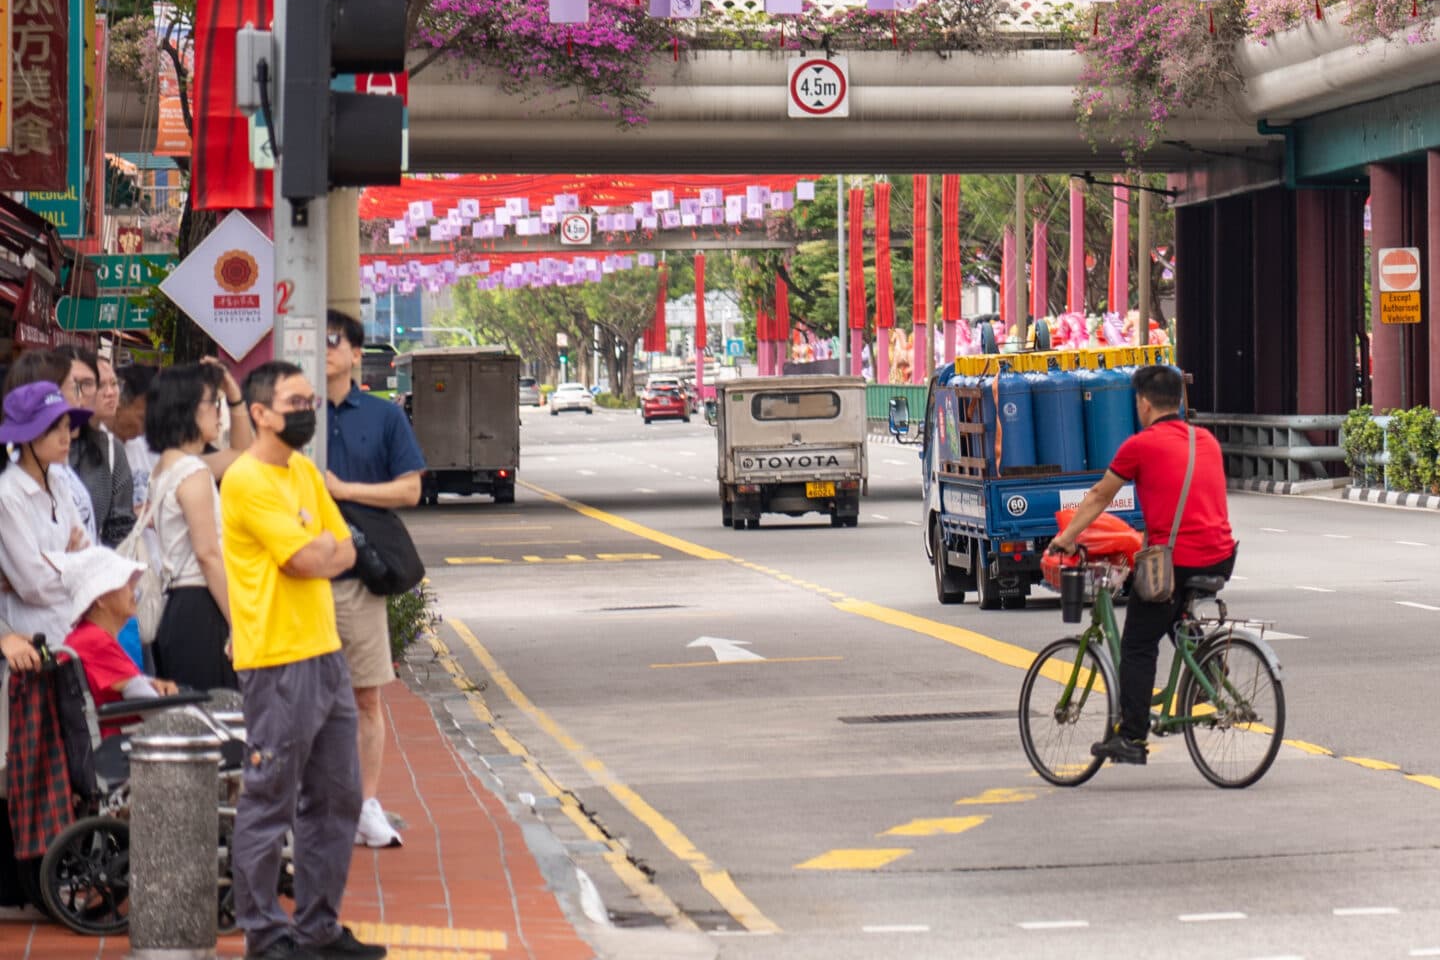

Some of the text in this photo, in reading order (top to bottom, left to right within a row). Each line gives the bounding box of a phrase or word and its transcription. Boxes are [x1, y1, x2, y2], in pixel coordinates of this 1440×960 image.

[800, 77, 837, 97] 4.5m
[276, 280, 289, 315] 2
[1389, 293, 1412, 303] Except
[1383, 304, 1419, 313] Authorised
[1387, 314, 1415, 323] Vehicles
[756, 455, 839, 469] TOYOTA
[1010, 498, 1025, 510] 60
